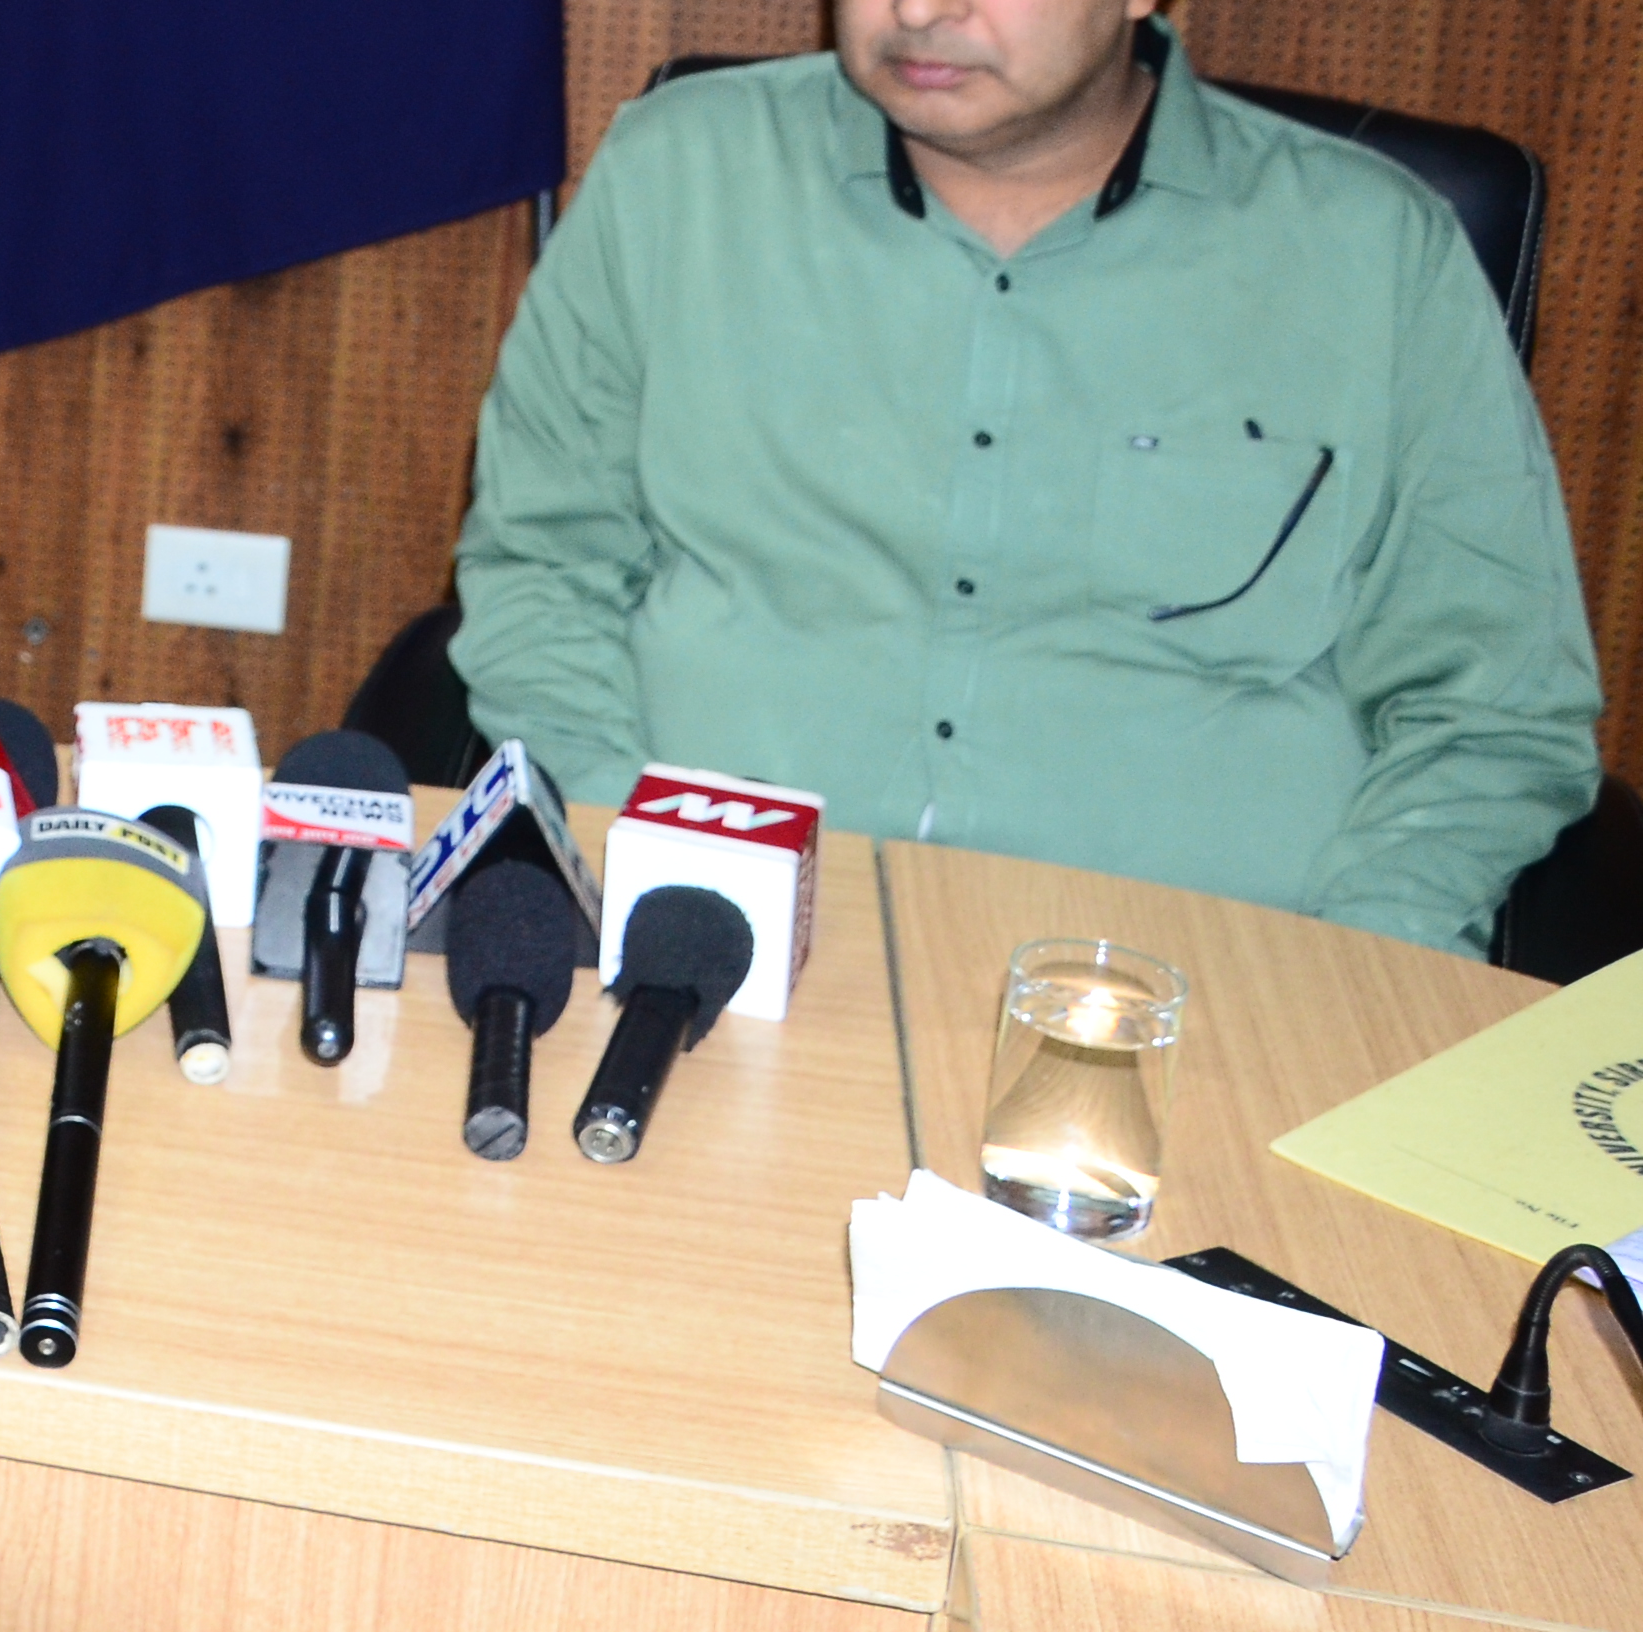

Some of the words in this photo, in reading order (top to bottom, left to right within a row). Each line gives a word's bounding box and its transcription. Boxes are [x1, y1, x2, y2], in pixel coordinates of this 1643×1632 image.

[320, 806, 405, 824] NEWS
[38, 818, 106, 833] DAILY
[120, 827, 181, 863] POST
